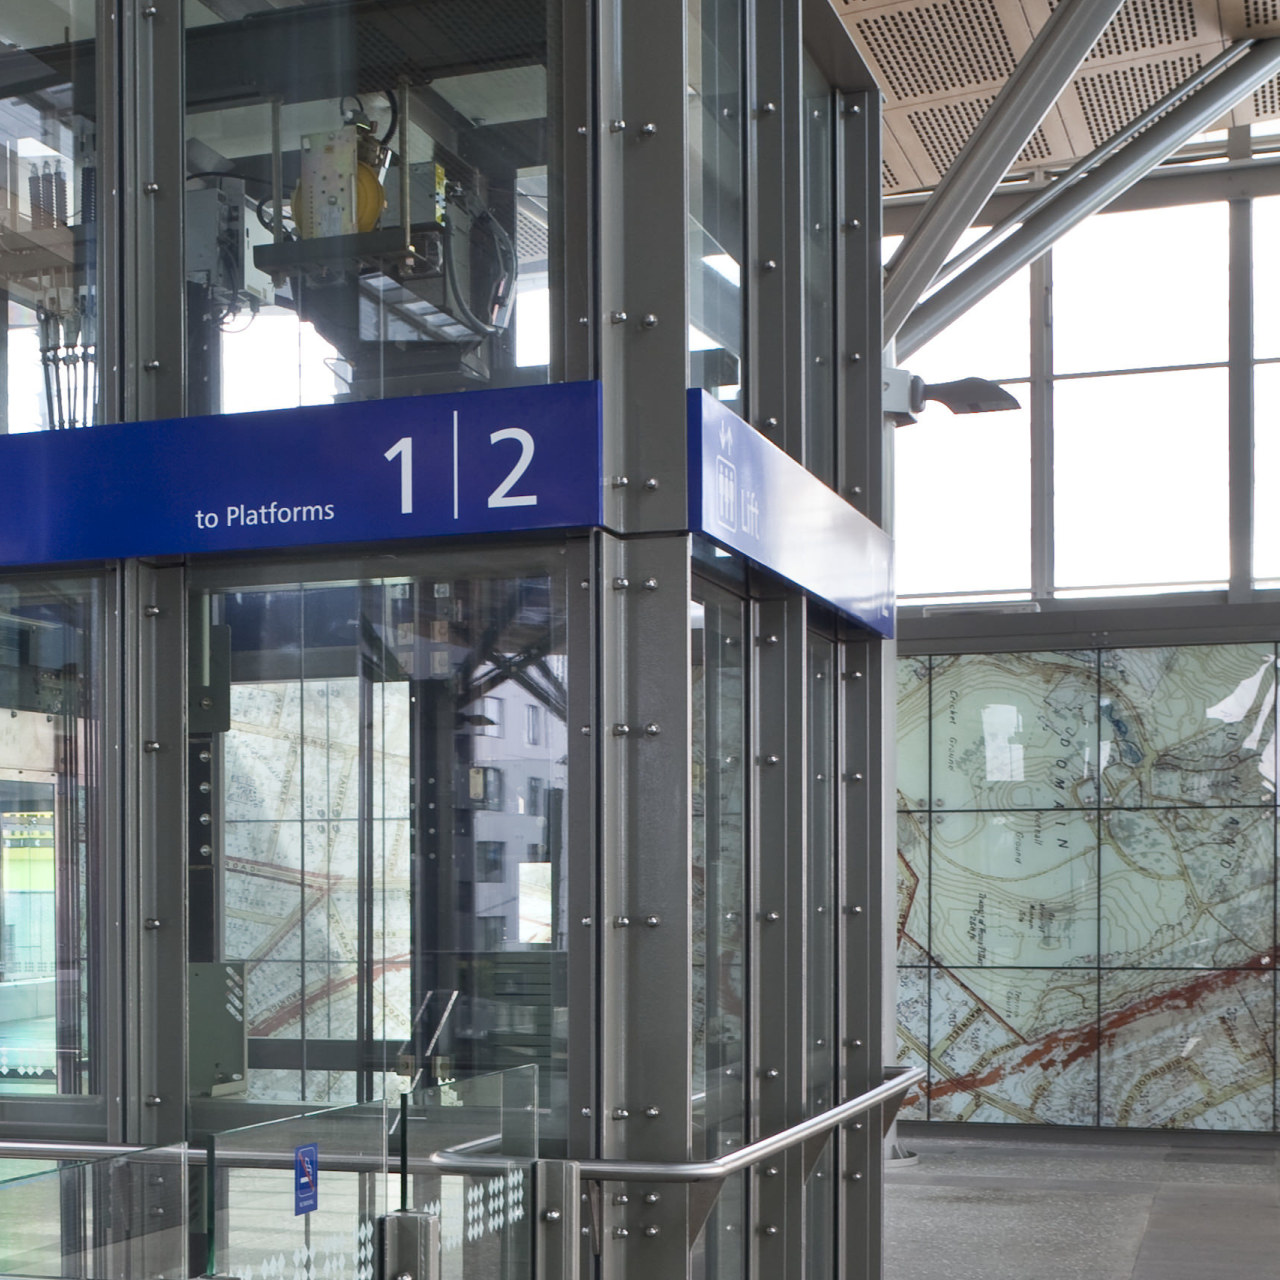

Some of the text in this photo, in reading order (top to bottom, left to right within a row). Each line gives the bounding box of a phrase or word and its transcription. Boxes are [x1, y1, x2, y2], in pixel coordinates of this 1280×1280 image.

[384, 427, 537, 514] 1 2
[195, 501, 335, 529] to Platforms
[740, 487, 761, 541] Lift
